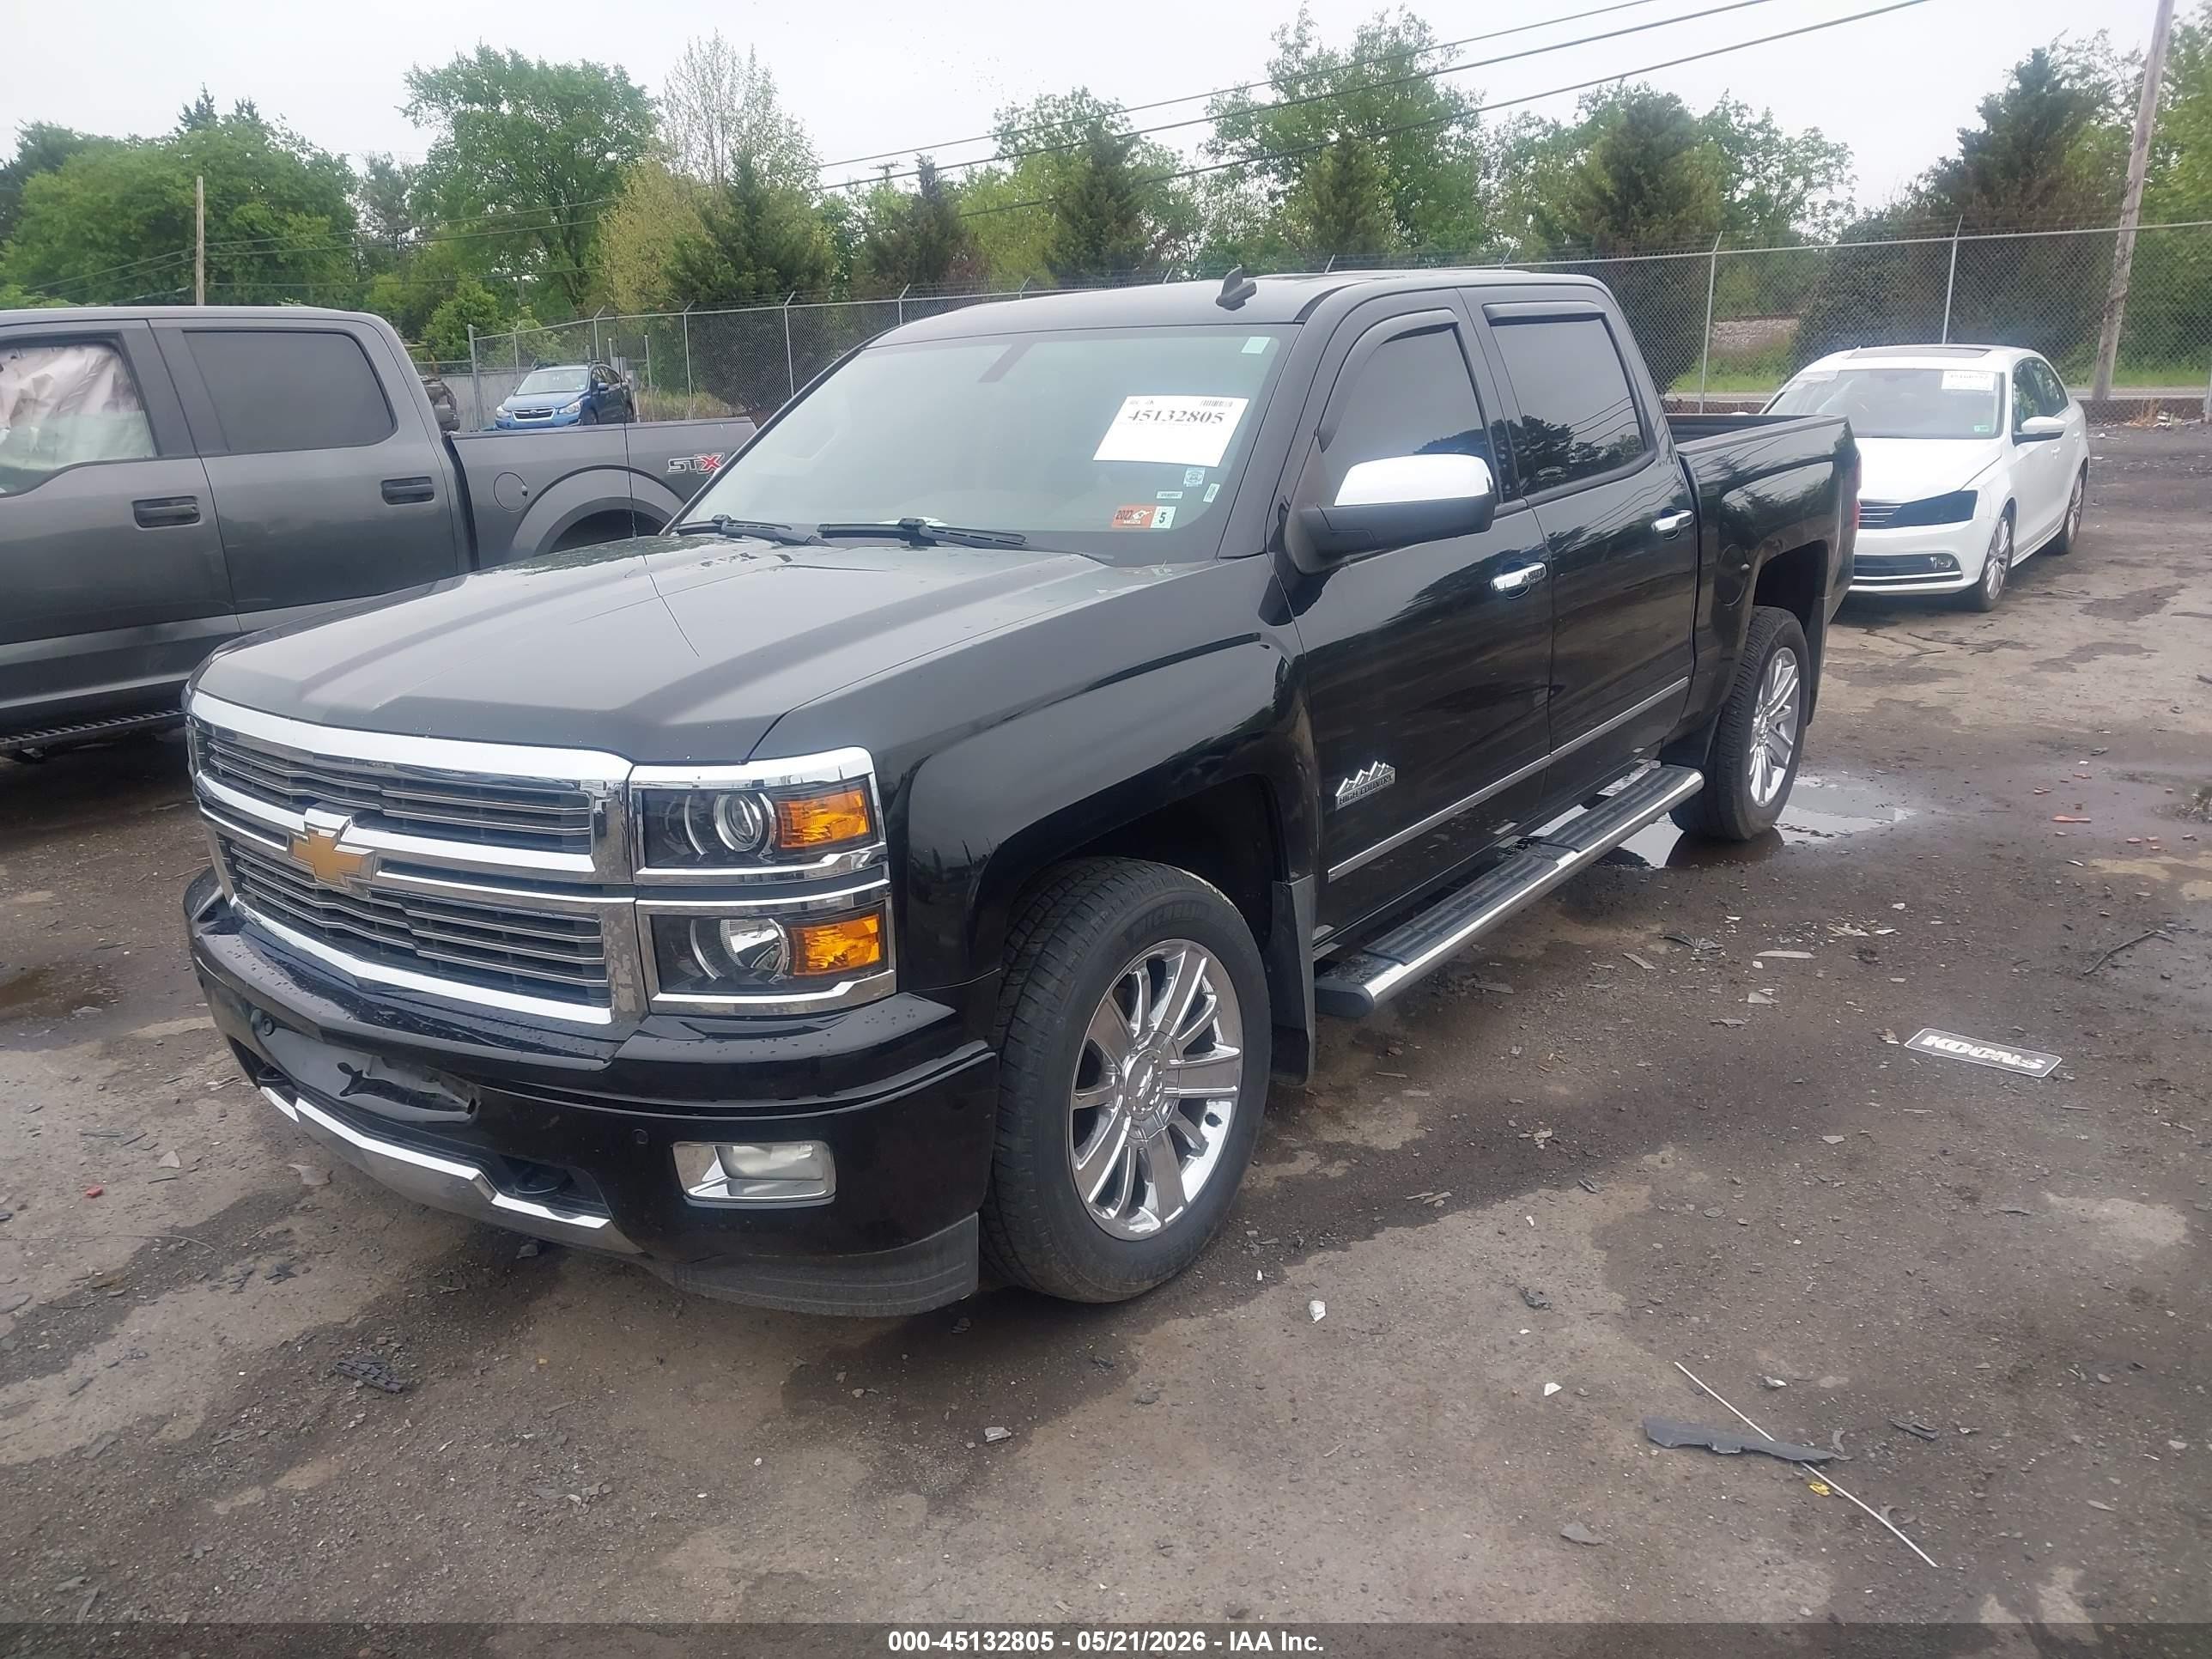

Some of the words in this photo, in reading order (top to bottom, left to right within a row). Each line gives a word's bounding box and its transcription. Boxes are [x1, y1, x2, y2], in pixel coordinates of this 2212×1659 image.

[1128, 409, 1225, 424] 45132805
[666, 452, 725, 474] STX
[1158, 512, 1167, 524] 5
